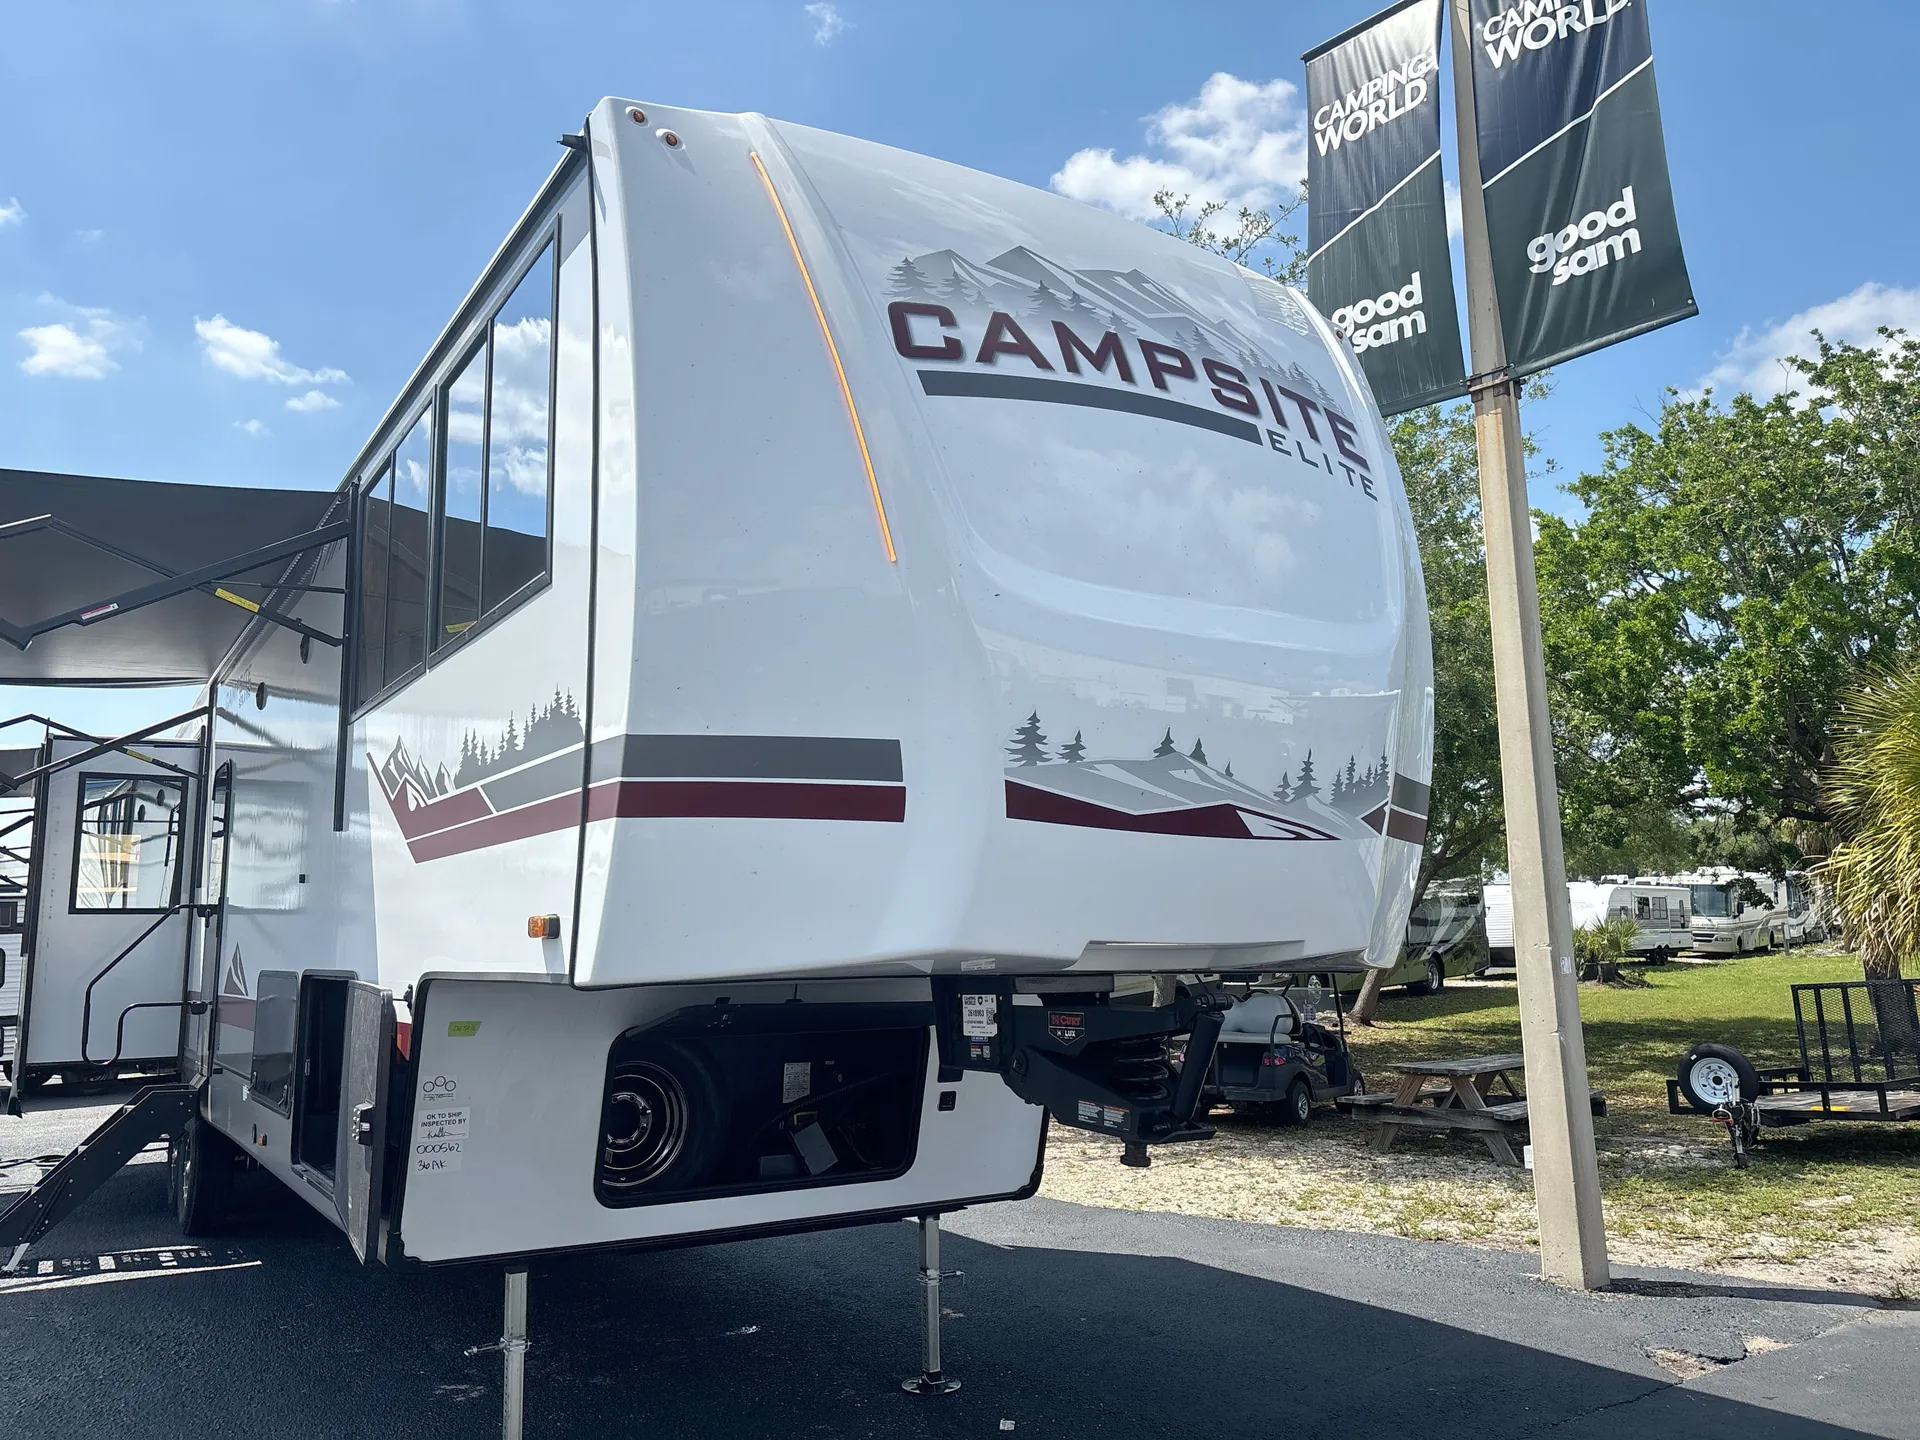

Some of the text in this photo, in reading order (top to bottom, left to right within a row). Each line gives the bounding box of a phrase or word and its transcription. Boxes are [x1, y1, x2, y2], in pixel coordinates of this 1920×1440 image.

[1313, 53, 1437, 131] CAMPING
[1526, 185, 1637, 274] good
[1551, 227, 1642, 286] sam
[1330, 271, 1423, 338] good
[1351, 309, 1427, 354] sam
[887, 301, 1371, 470] CAMPSITE
[1266, 427, 1379, 502] ELITE
[416, 1142, 462, 1155] 000562
[421, 1119, 457, 1127] INSPECTED
